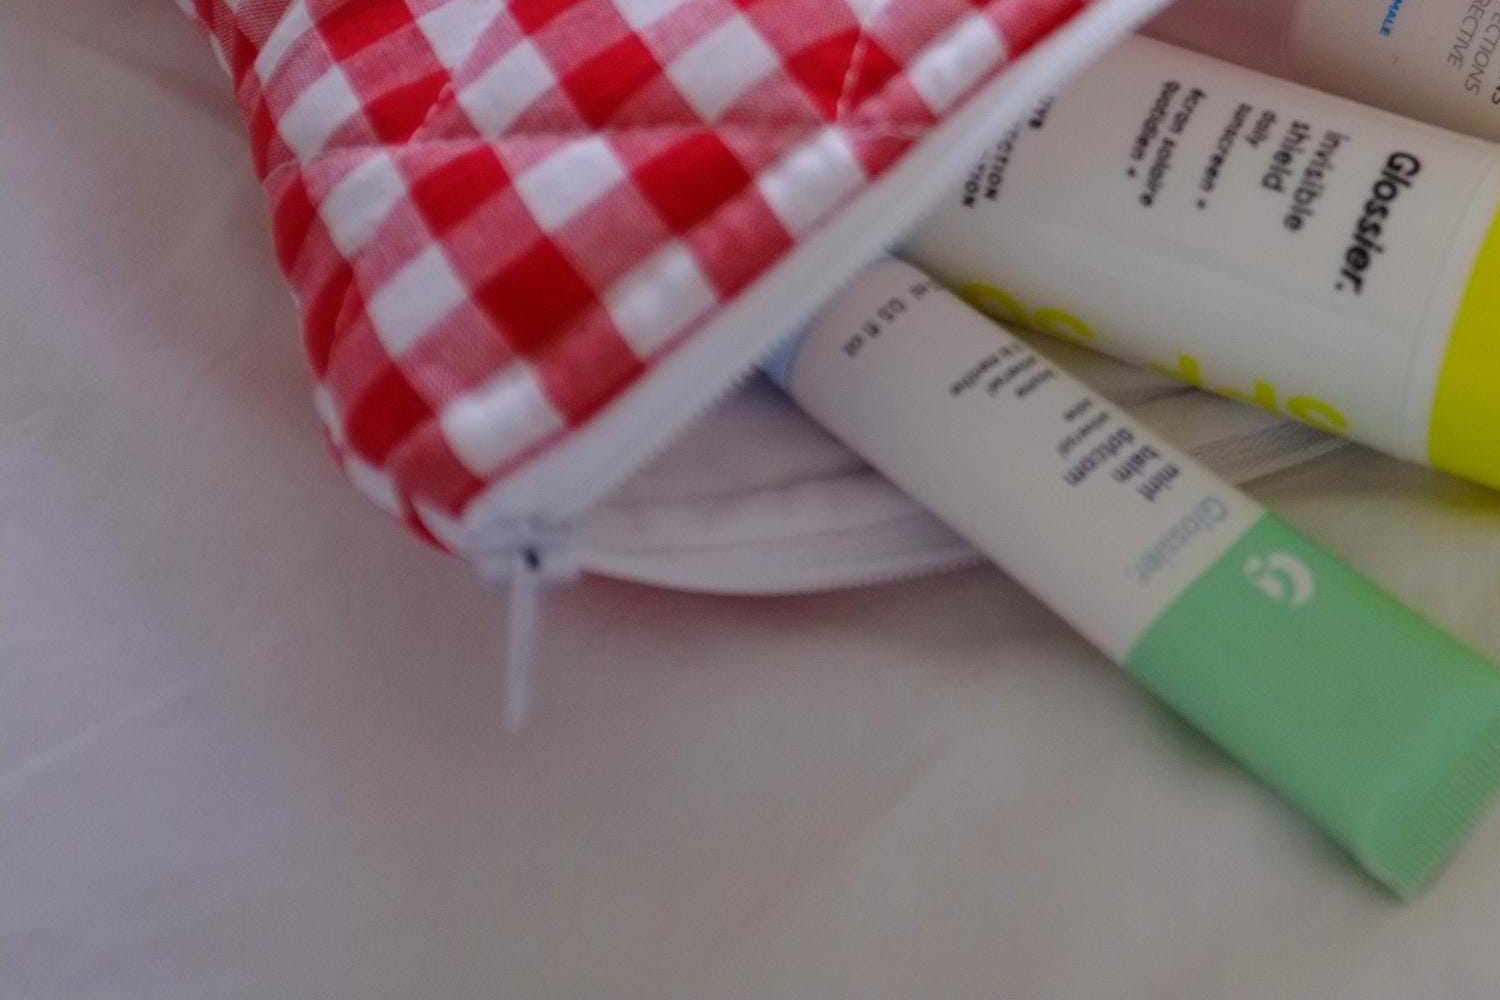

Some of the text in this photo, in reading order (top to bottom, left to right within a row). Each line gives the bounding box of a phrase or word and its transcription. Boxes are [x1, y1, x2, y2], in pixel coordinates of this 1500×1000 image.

[1130, 80, 1181, 162] quotidien
[1201, 102, 1253, 193] sunscreen
[1243, 108, 1278, 149] daily
[1260, 119, 1312, 194] shield
[1139, 135, 1178, 209] solaire
[1282, 130, 1350, 233] invisible
[1334, 150, 1422, 295] Glossier.
[1062, 427, 1135, 487] dotcom
[1112, 444, 1160, 484] balm
[1137, 462, 1181, 504] mint
